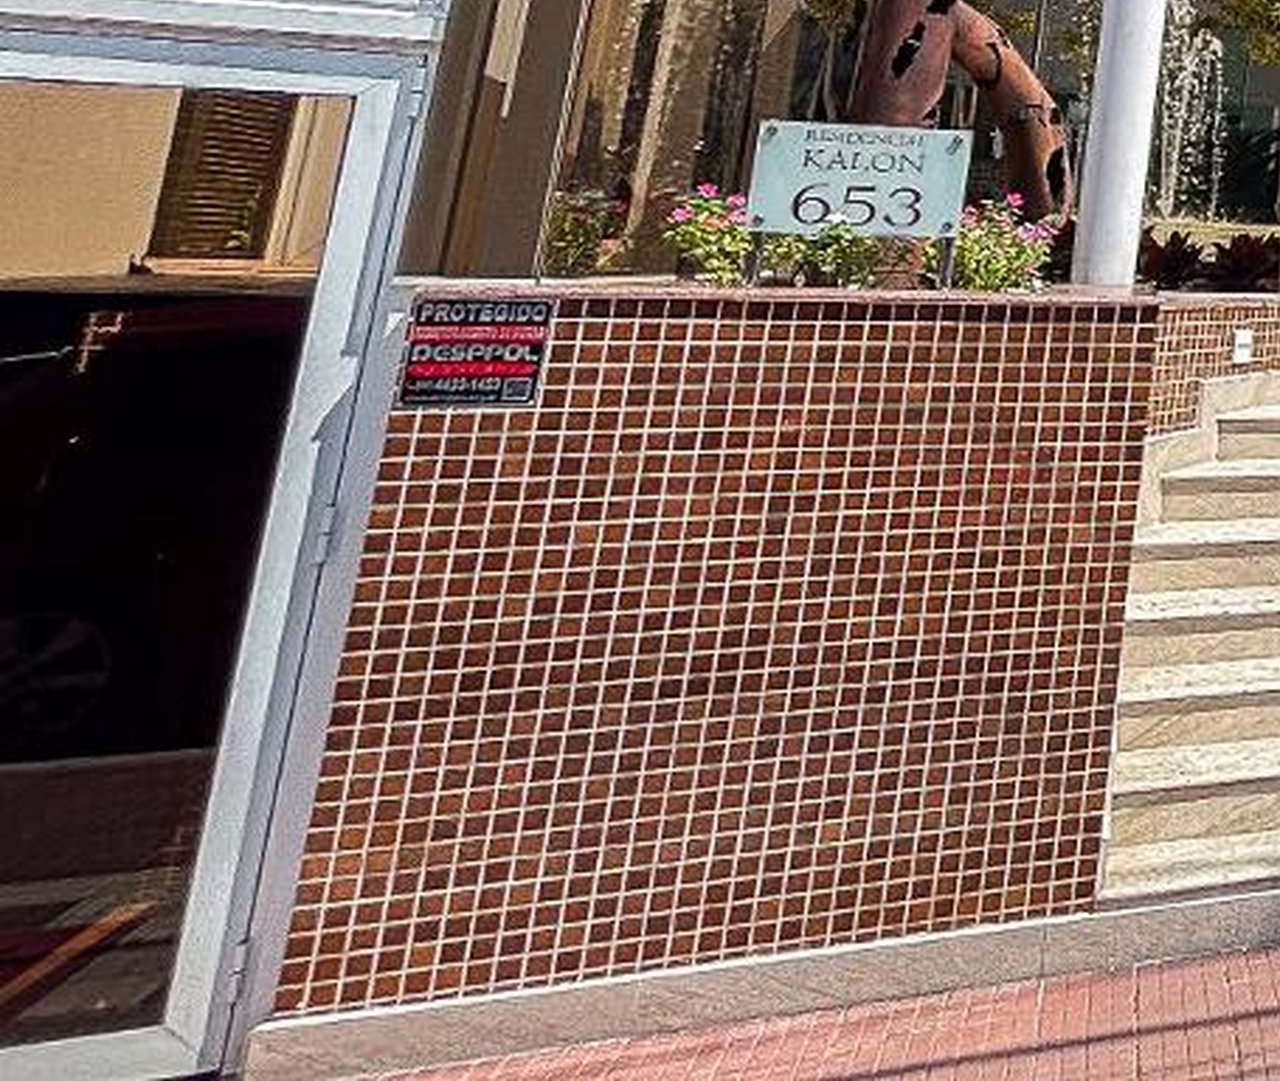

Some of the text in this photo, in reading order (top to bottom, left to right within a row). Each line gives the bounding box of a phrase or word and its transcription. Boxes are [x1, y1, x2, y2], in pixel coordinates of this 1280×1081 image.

[803, 149, 925, 173] KALON
[792, 183, 923, 226] 653
[420, 303, 548, 322] PROTEGIDO
